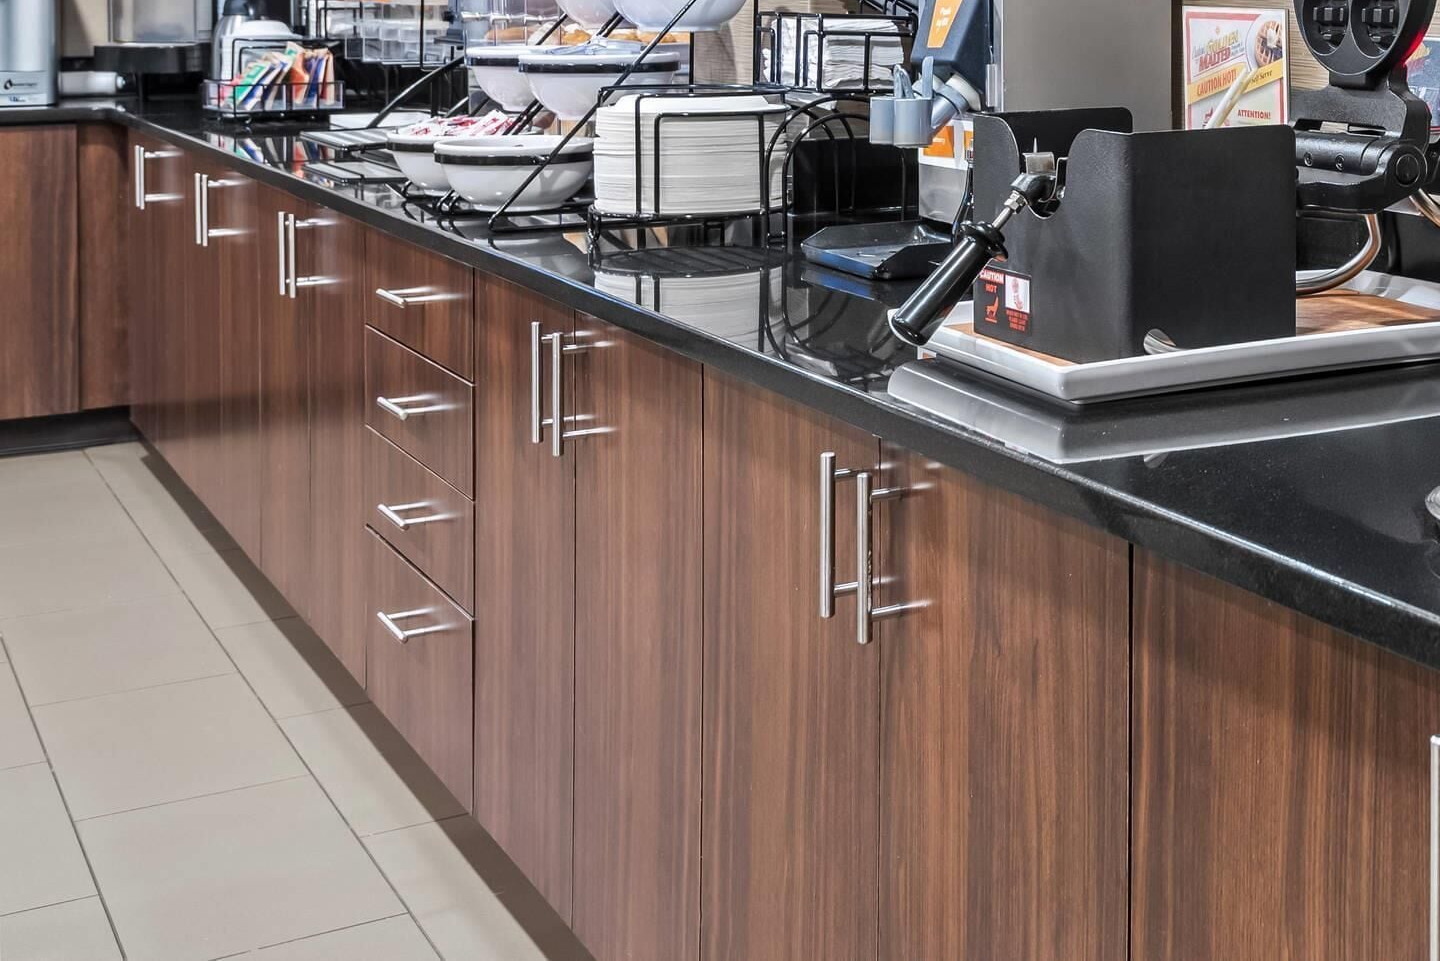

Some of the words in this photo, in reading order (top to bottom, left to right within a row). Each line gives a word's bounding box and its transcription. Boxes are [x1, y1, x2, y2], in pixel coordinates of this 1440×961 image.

[1199, 47, 1231, 71] MALTED
[1197, 75, 1222, 96] CAUTION
[1238, 110, 1271, 119] ATTENTION!
[980, 269, 1004, 284] CAUTION
[986, 284, 997, 293] HOT
